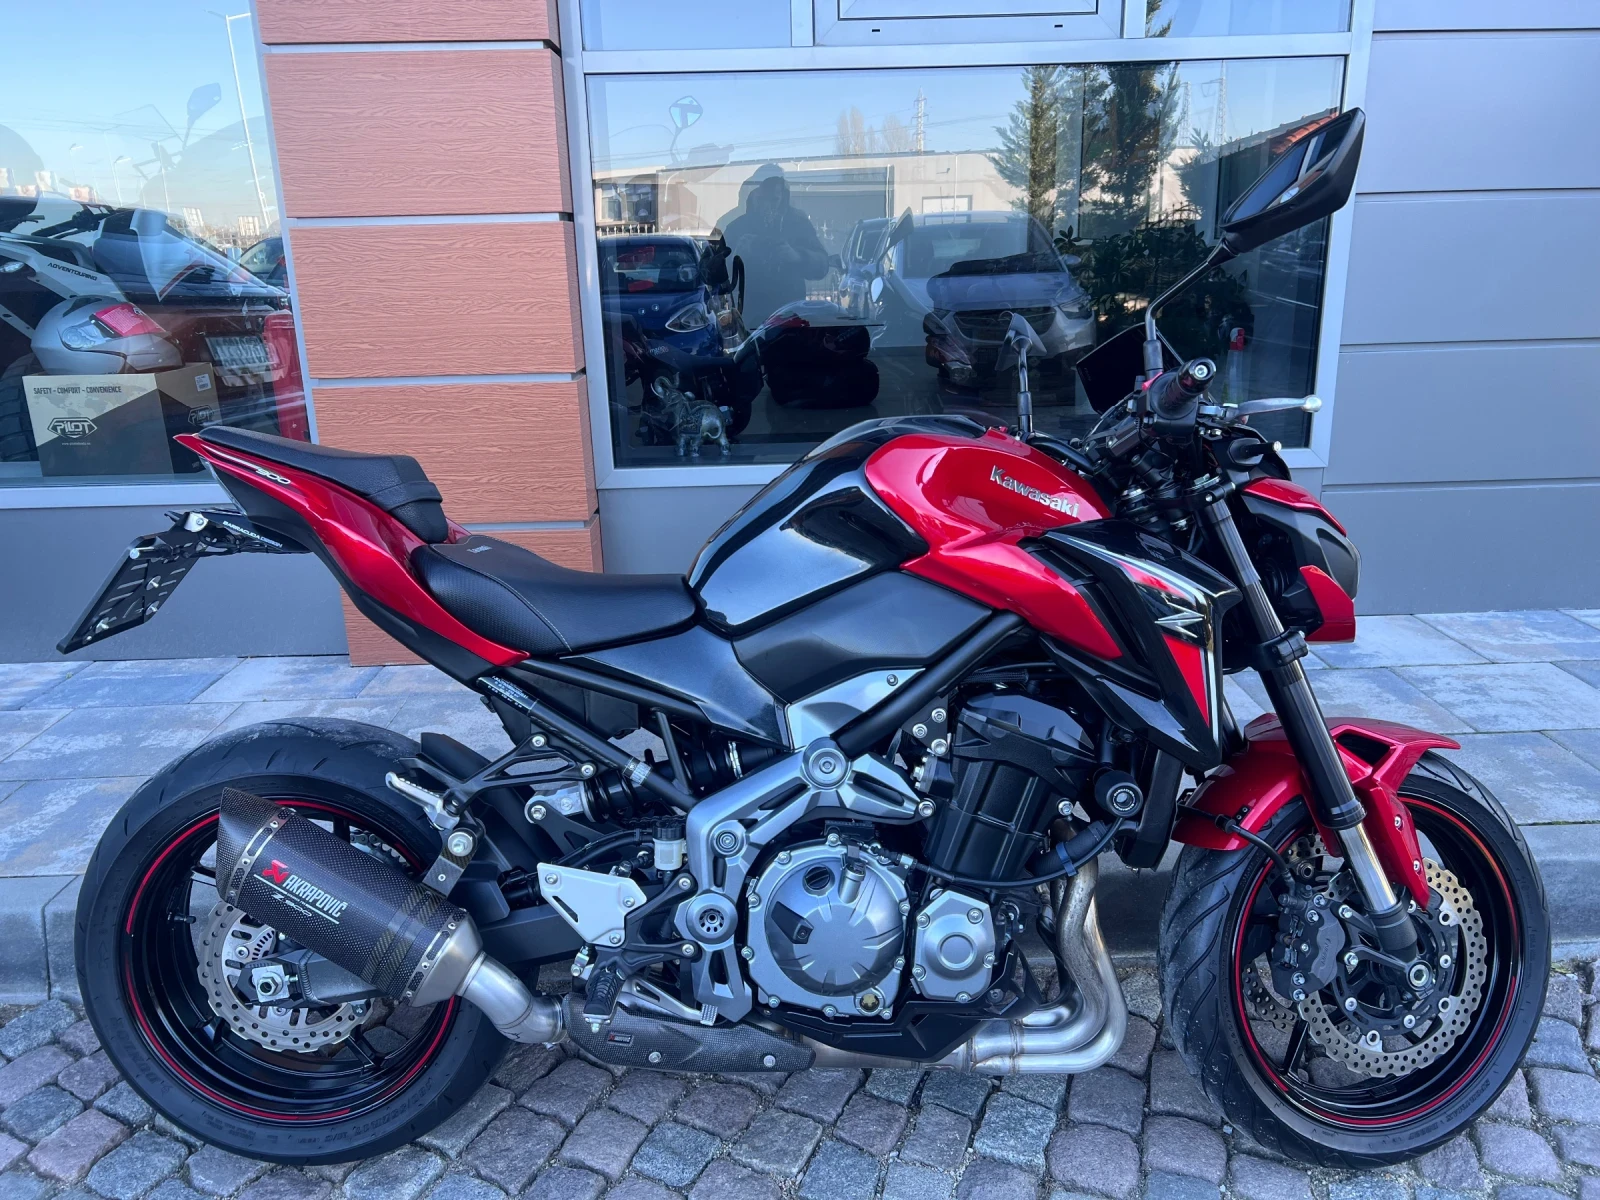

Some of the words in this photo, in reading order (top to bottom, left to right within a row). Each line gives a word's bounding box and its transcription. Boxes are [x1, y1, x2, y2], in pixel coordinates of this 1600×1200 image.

[47, 262, 98, 281] ADVENTOURING
[86, 386, 122, 394] CONVENIENCE
[989, 464, 1080, 518] Kawasaki
[222, 520, 260, 539] BARRACUDA
